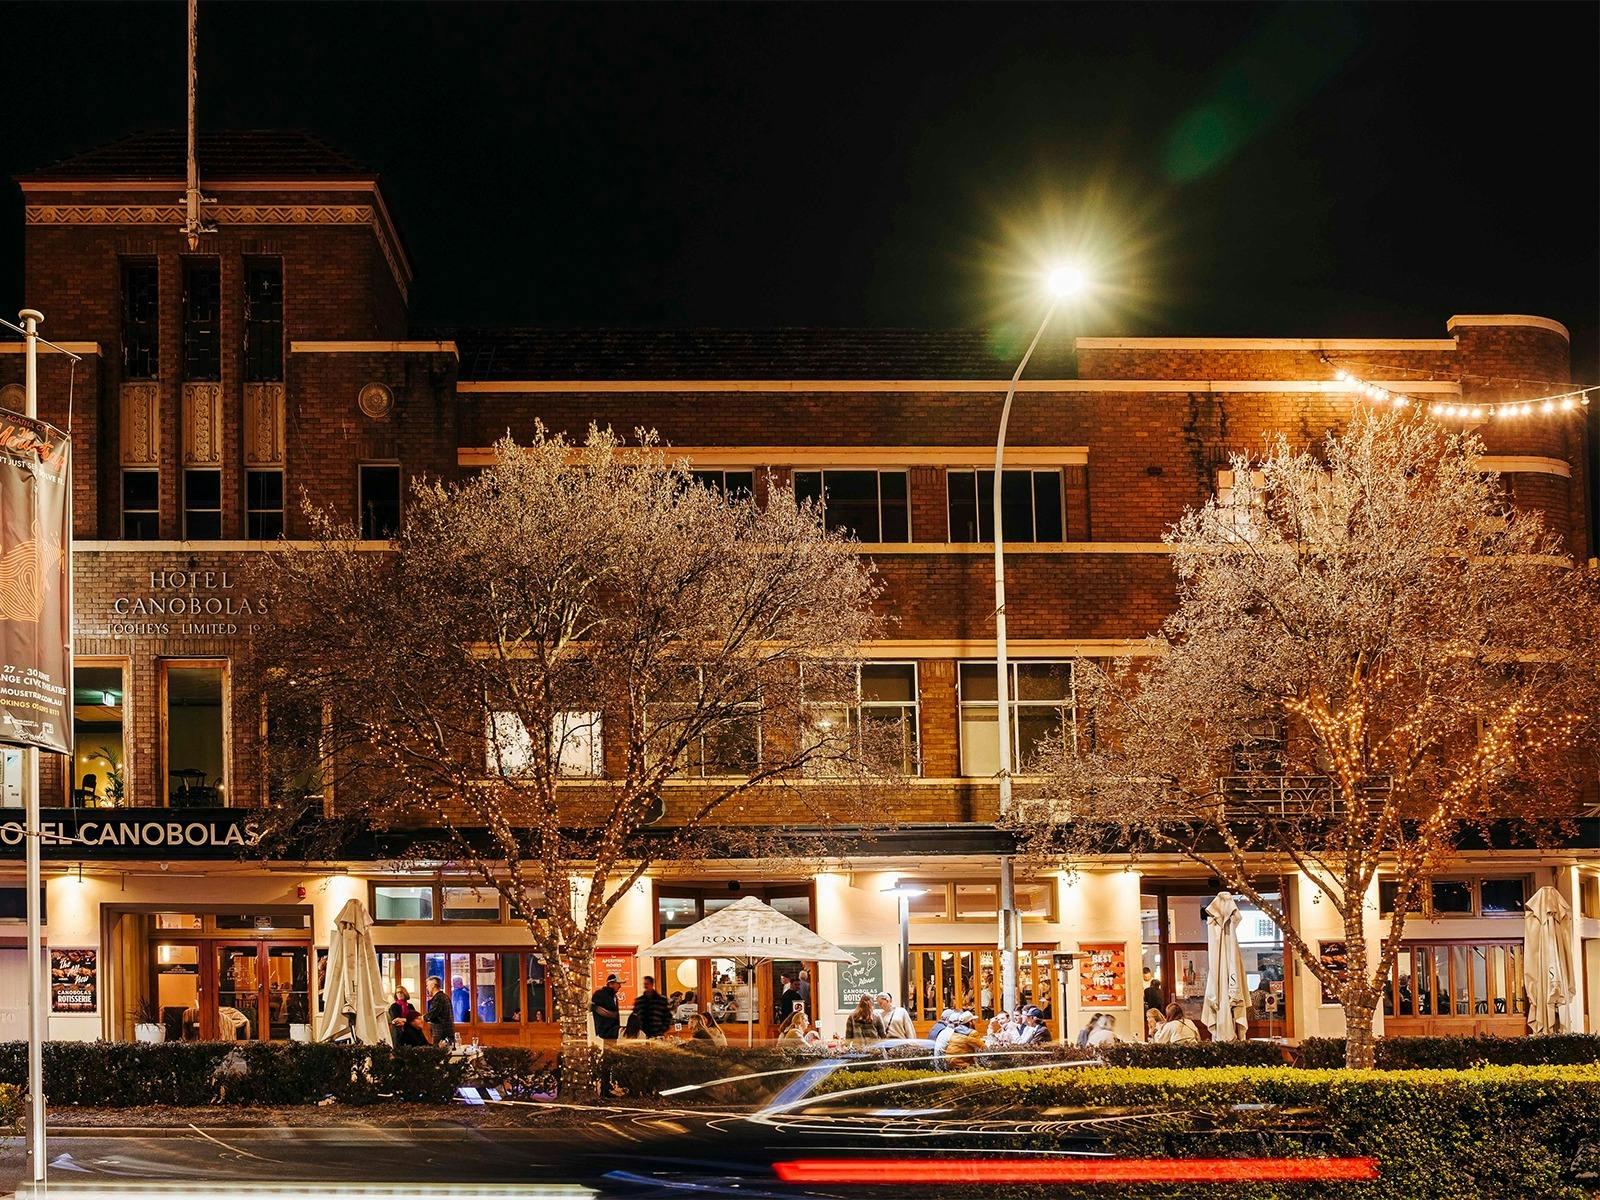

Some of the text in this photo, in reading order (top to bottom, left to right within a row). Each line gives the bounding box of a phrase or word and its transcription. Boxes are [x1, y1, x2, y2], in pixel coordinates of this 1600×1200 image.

[8, 458, 25, 468] JUST
[150, 571, 235, 589] HOTEL
[114, 597, 269, 615] CANOBOLAS
[107, 623, 170, 635] TOOHEYS
[182, 623, 237, 635] LIMITED
[3, 665, 15, 673] 27
[26, 668, 38, 677] 30
[0, 822, 259, 845] OEL CANOBOLAS
[701, 935, 792, 944] ROSS HILL
[1091, 954, 1113, 963] BEST
[57, 995, 92, 1003] ROTISSERIE
